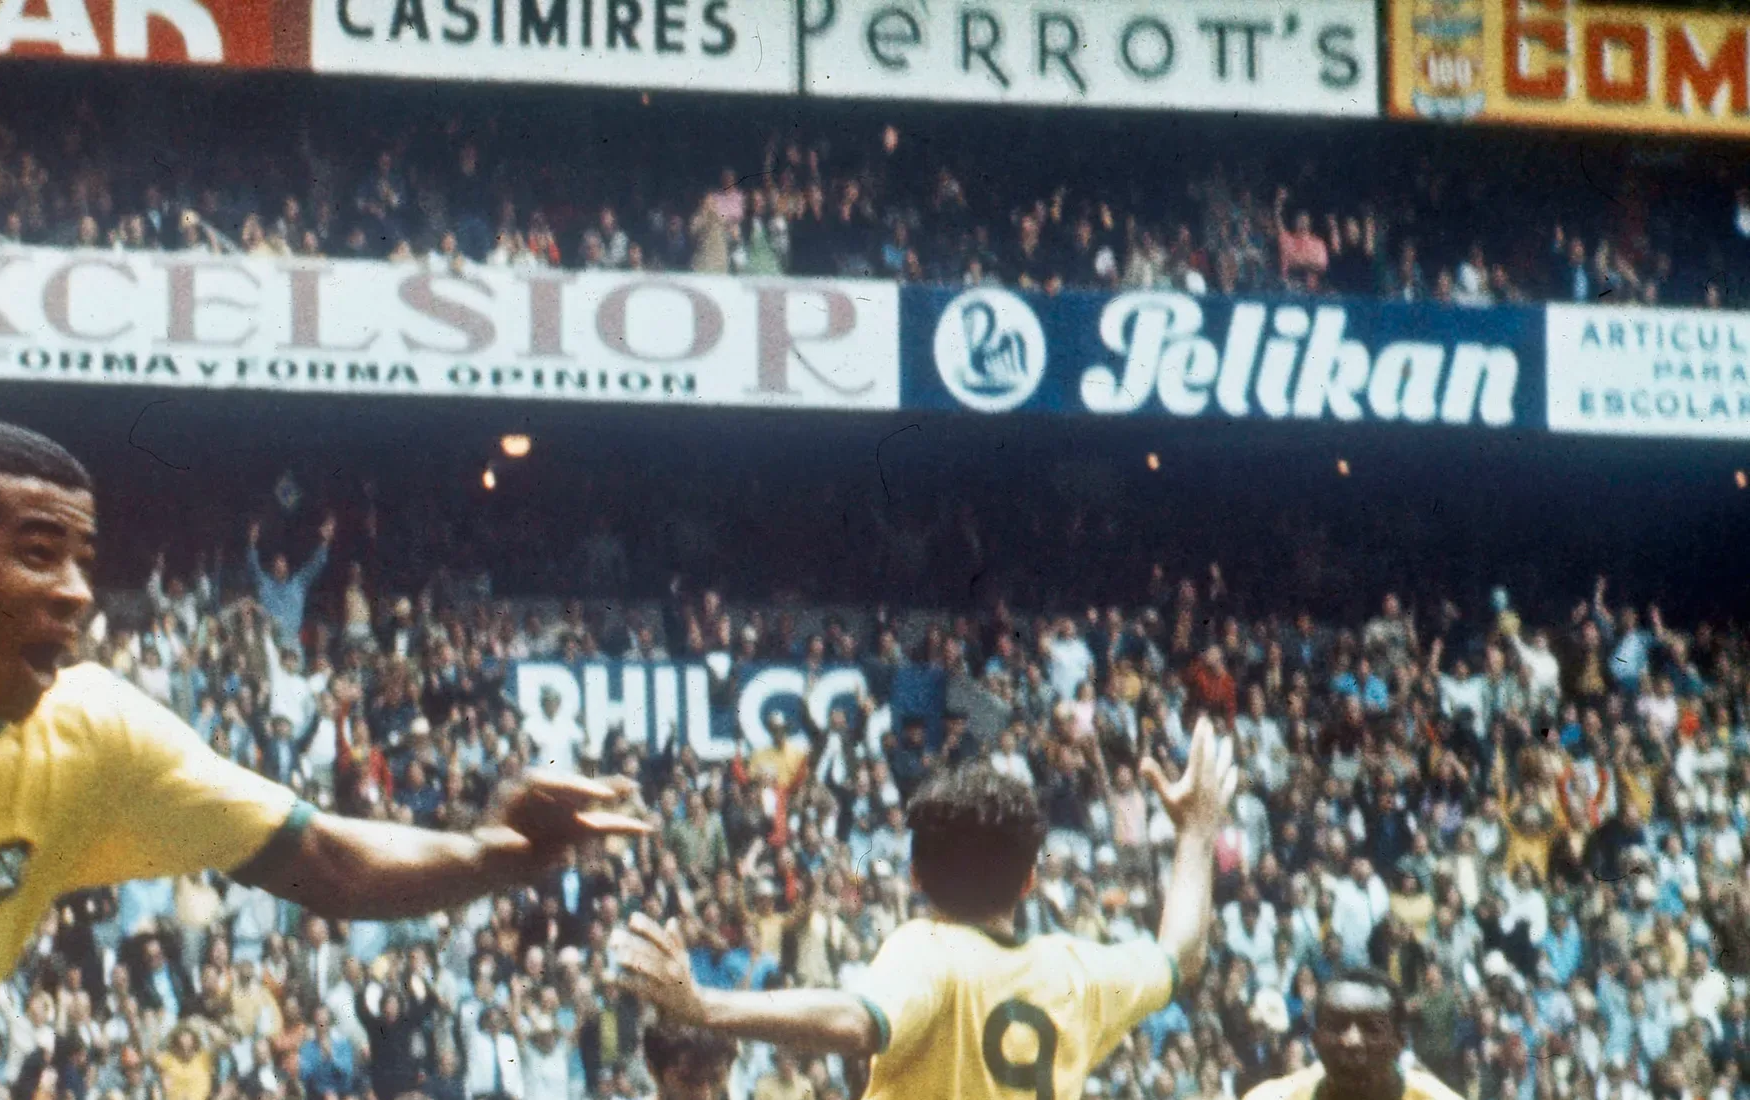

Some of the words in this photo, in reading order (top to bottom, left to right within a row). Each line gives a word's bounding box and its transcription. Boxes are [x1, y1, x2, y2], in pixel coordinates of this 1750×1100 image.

[335, 0, 739, 56] CASIMIRES
[235, 357, 419, 386] FORMA
[447, 362, 698, 395] OPINION
[1079, 290, 1519, 427] Pelikan
